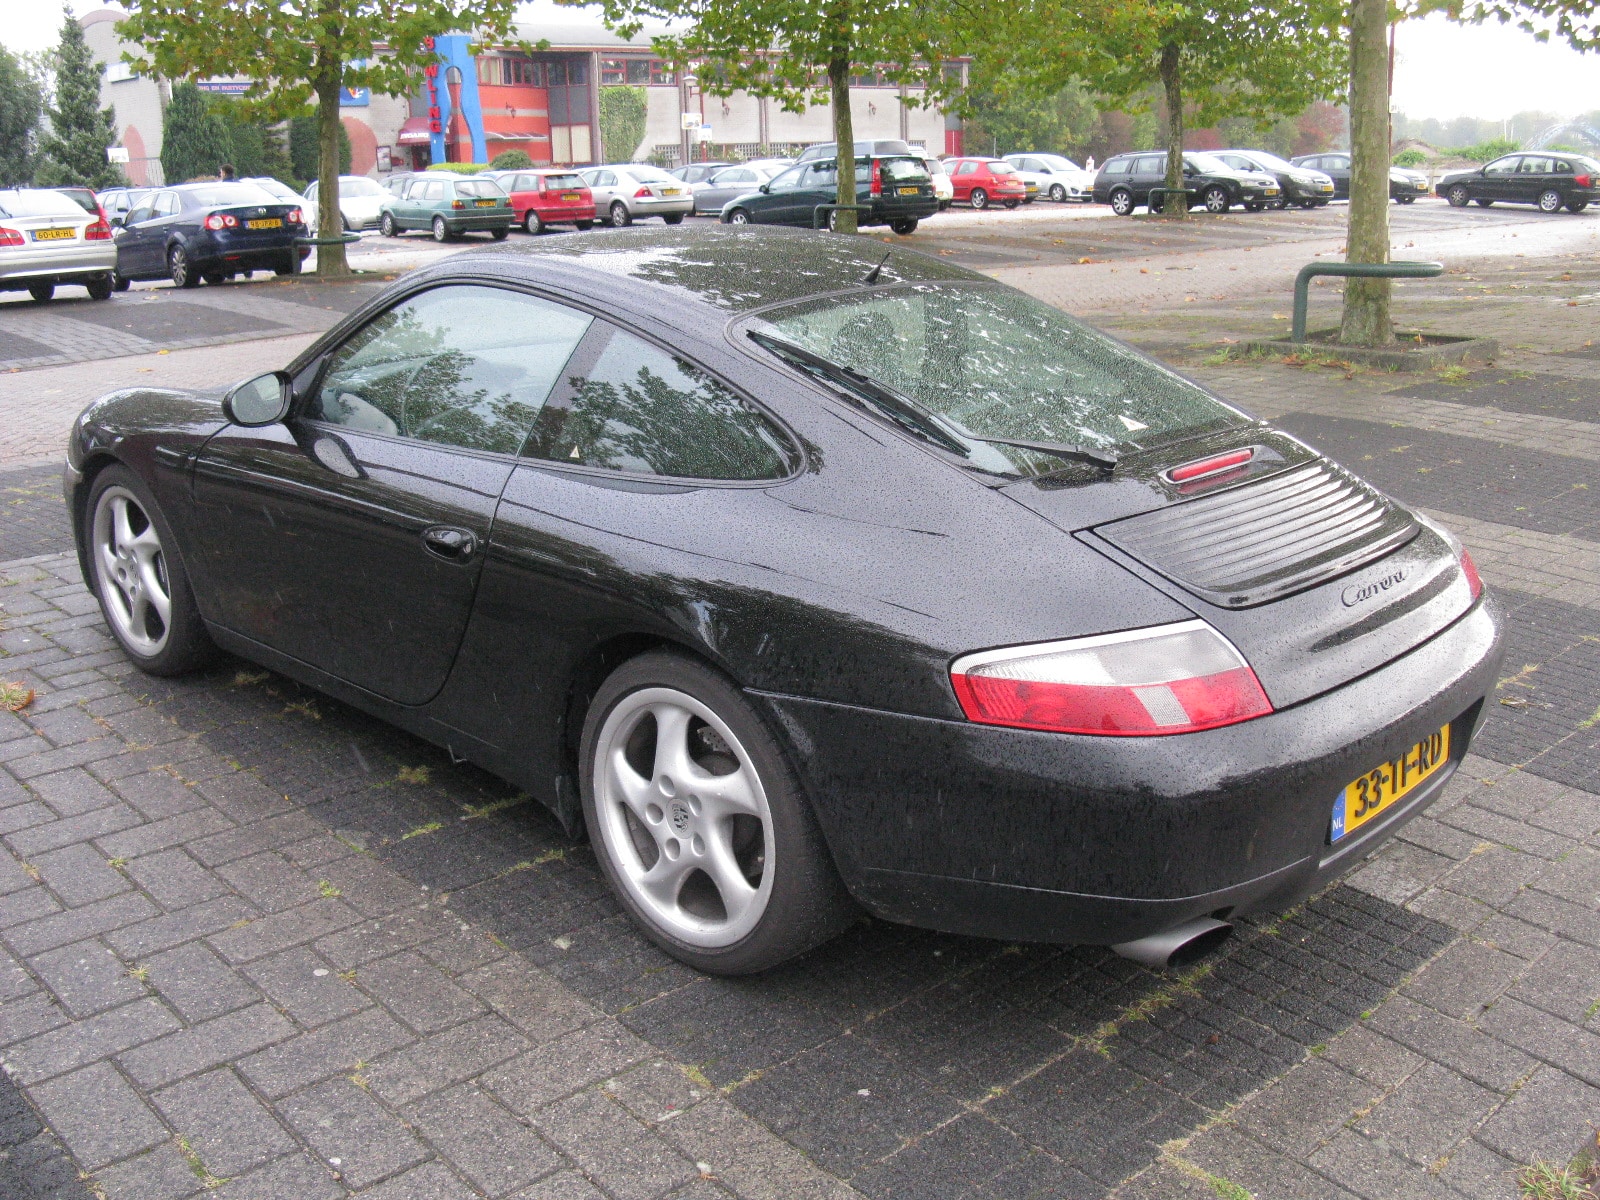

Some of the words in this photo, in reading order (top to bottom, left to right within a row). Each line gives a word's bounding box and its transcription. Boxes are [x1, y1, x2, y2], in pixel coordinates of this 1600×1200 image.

[423, 35, 441, 133] BWLING
[38, 229, 74, 239] 60-LR-HL
[1341, 569, 1407, 608] Carrera
[1354, 731, 1443, 818] 33-TF-RD
[1332, 816, 1344, 833] NL
